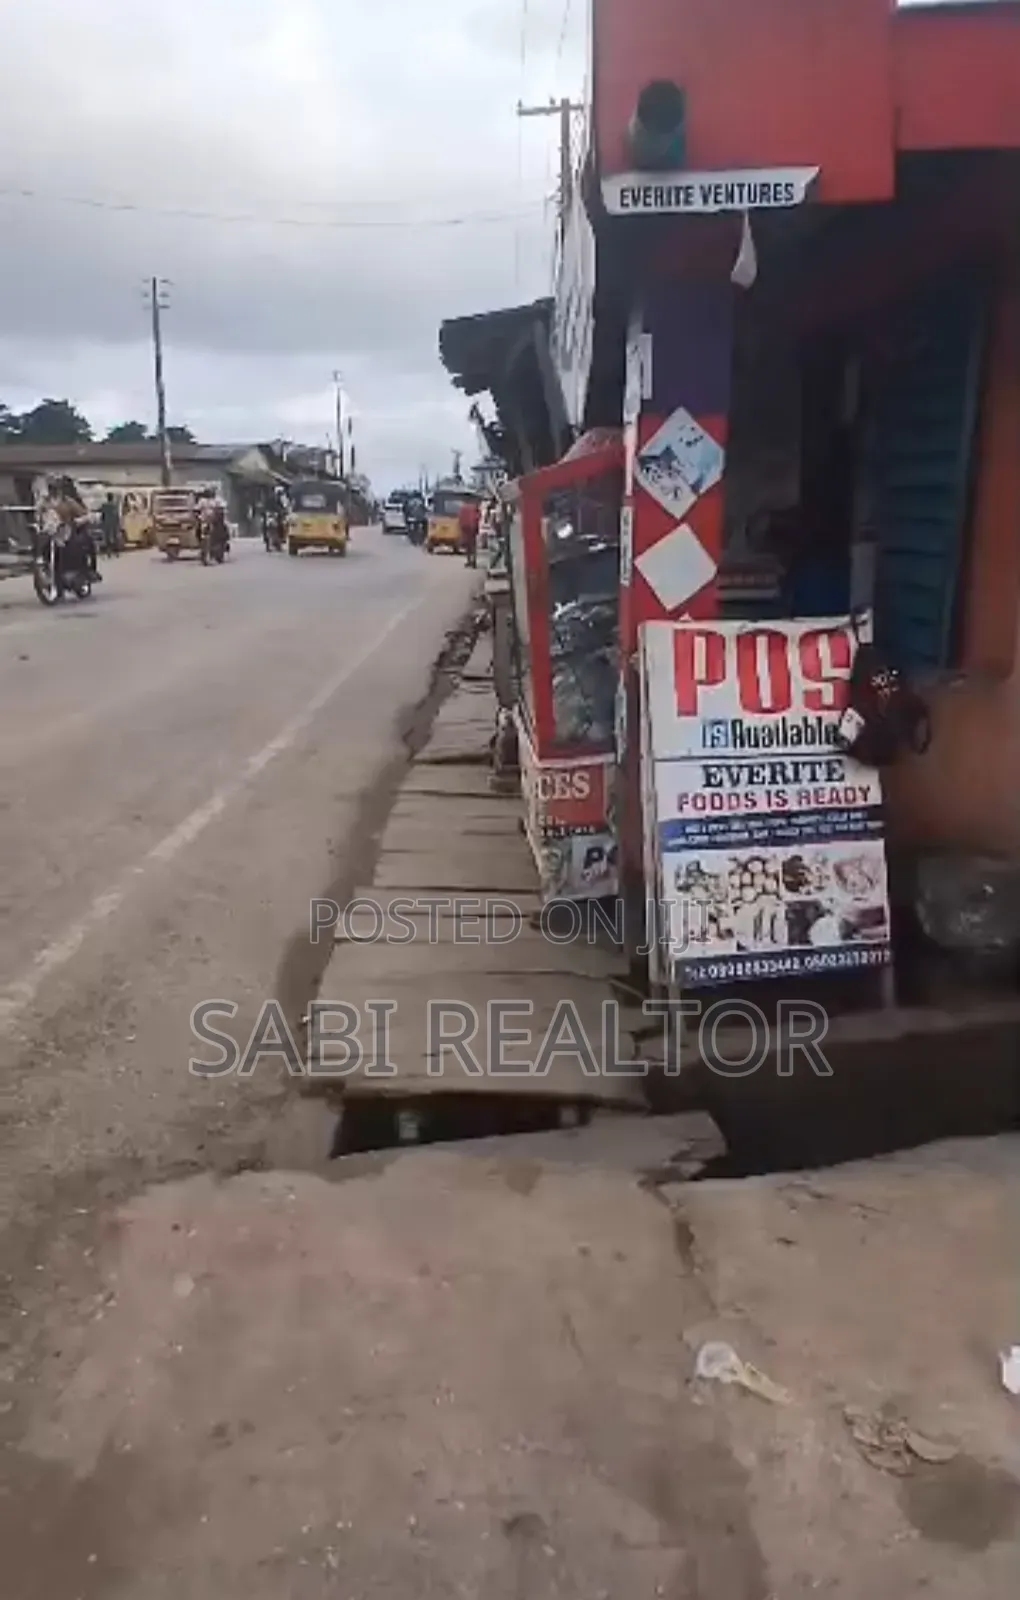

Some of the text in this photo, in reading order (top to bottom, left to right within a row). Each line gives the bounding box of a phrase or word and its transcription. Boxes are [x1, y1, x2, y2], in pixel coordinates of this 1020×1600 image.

[619, 182, 794, 207] EVERITE VENTURES
[674, 628, 851, 717] POS
[702, 760, 845, 788] EVERITE
[677, 785, 871, 813] FOODS IS READY
